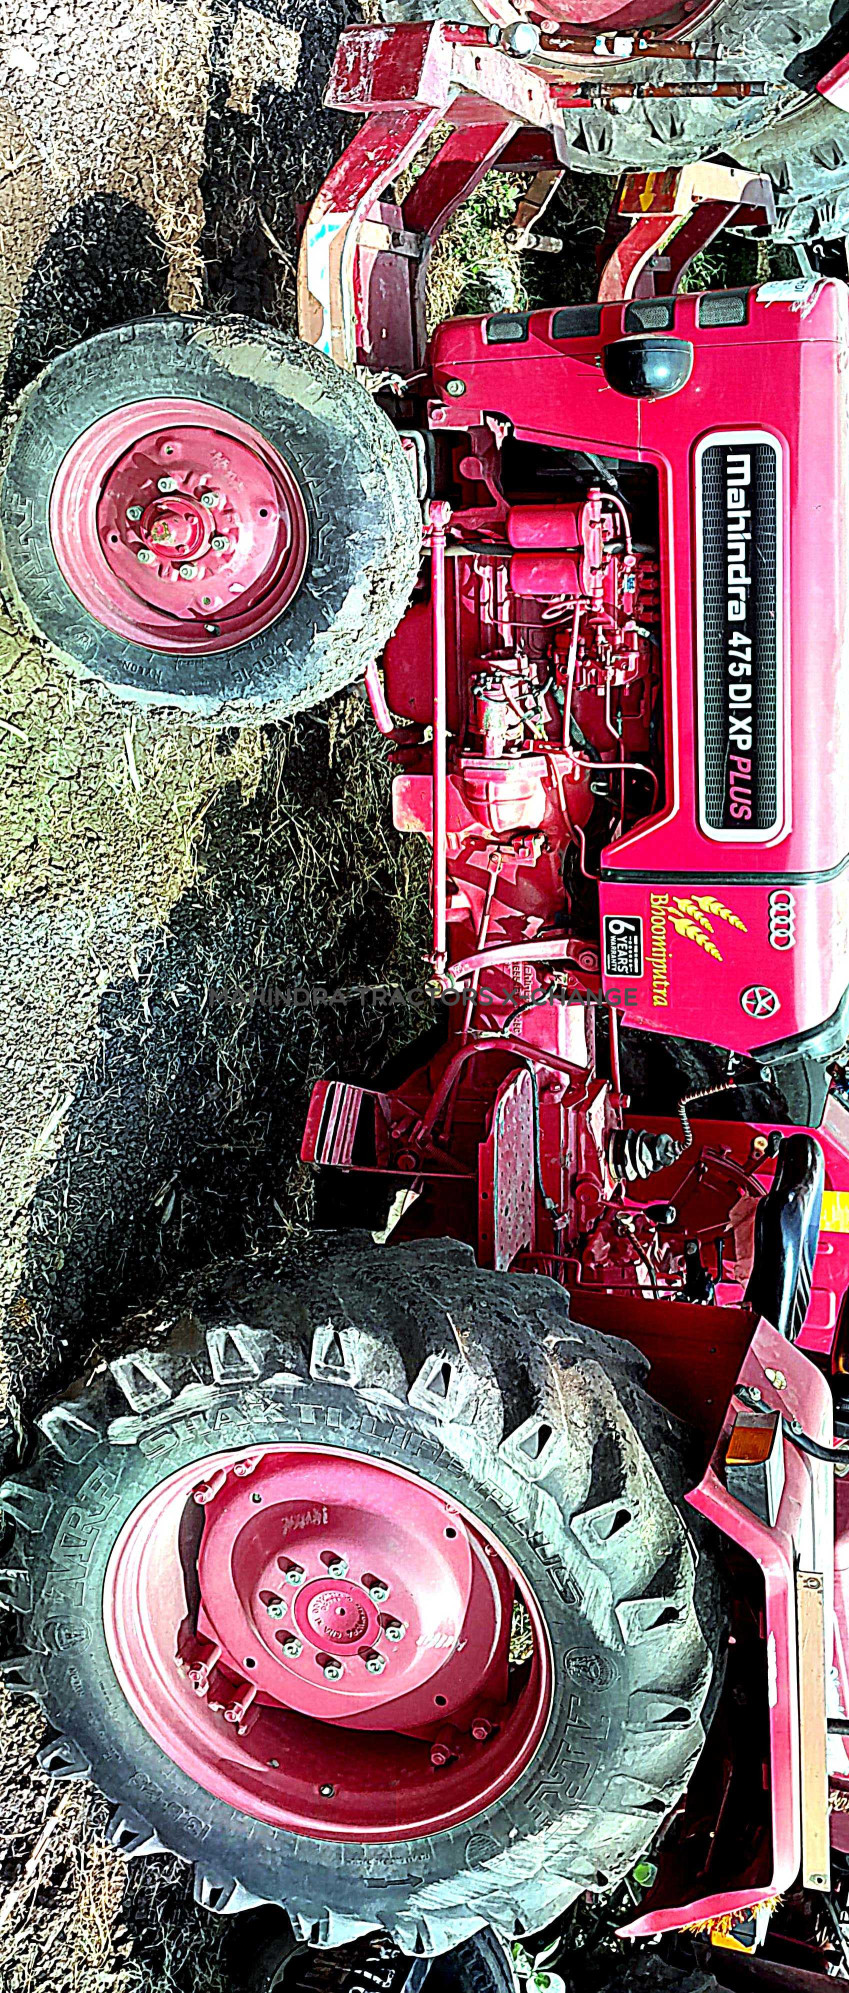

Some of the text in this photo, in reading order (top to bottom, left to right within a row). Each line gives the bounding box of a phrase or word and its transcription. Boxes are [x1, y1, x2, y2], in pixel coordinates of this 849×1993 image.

[727, 454, 752, 820] Mahindra 475 DI XP PLUS
[608, 919, 636, 935] 6
[645, 893, 673, 1007] Bhoomiputra
[40, 1464, 121, 1607] MRF
[134, 1398, 584, 1608] SHAKTI LIFE PLUS
[521, 1694, 610, 1832] MRF
